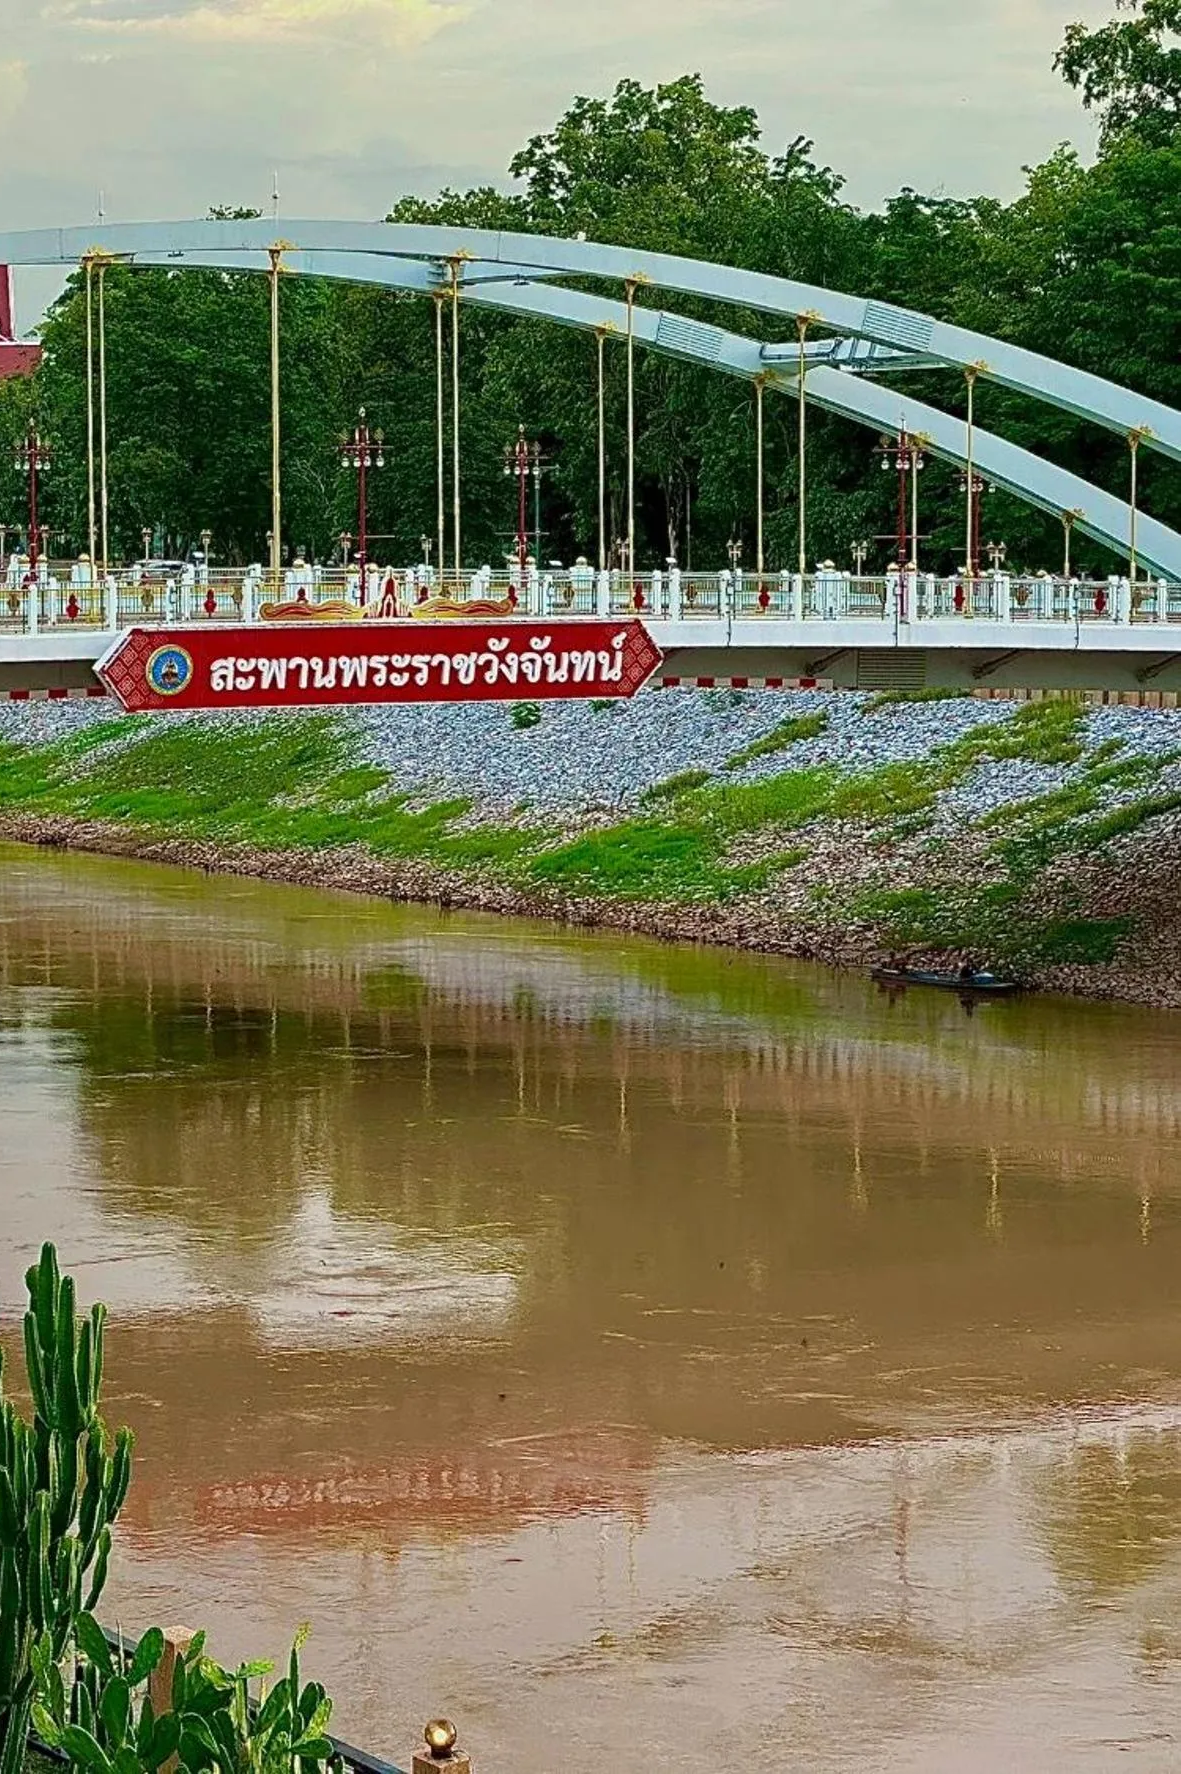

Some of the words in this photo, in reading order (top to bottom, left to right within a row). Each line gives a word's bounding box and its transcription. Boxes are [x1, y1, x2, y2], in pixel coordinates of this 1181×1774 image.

[209, 631, 627, 691] สะพานพระราชวังจันทน์
